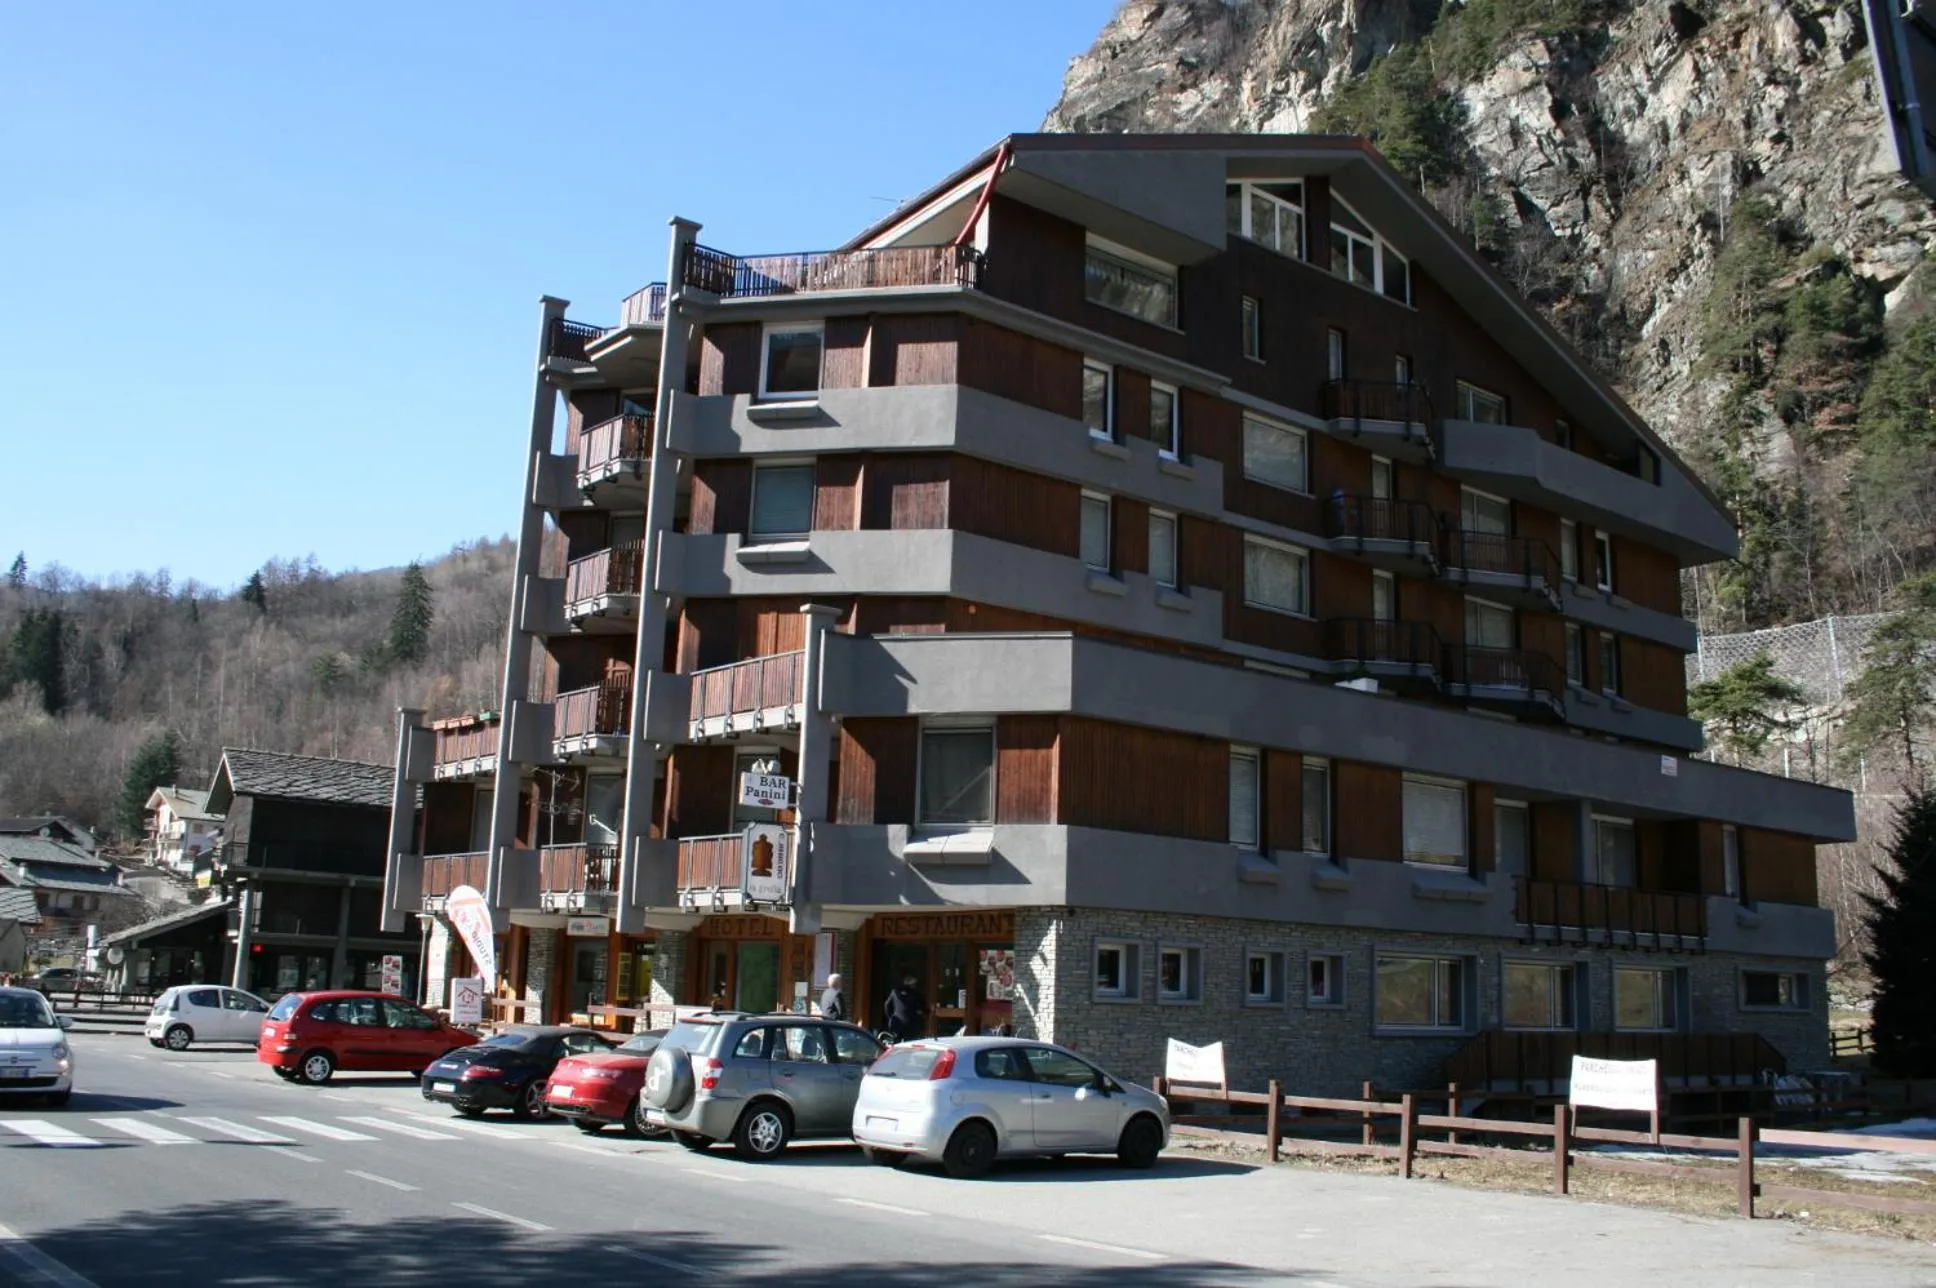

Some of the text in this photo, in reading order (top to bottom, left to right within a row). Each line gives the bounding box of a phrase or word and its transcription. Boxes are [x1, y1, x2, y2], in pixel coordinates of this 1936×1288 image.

[760, 776, 786, 789] BAR
[745, 786, 786, 800] Panini
[708, 917, 775, 936] HOTEL
